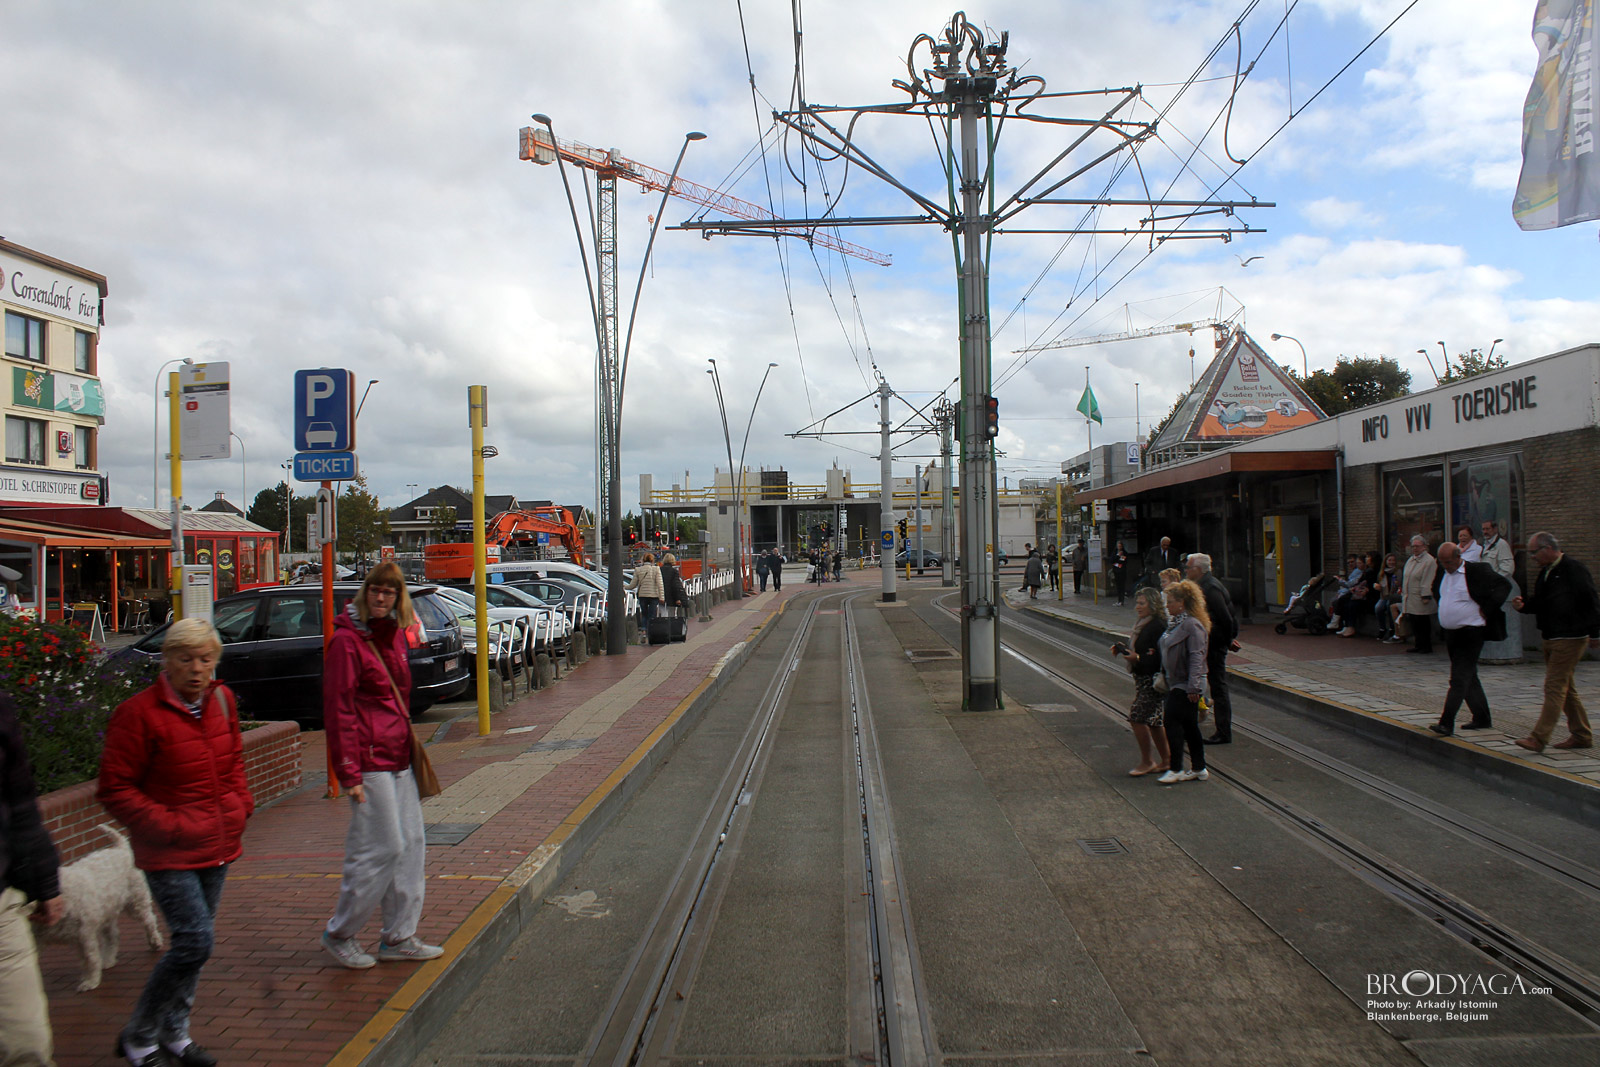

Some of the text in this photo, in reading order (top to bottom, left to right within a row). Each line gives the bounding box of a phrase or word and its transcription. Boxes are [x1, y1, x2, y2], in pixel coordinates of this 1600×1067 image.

[11, 271, 96, 317] Corsendonk bier
[306, 375, 335, 417] P
[1362, 375, 1537, 443] INFO VVV TOERISME
[298, 457, 350, 474] TICKET
